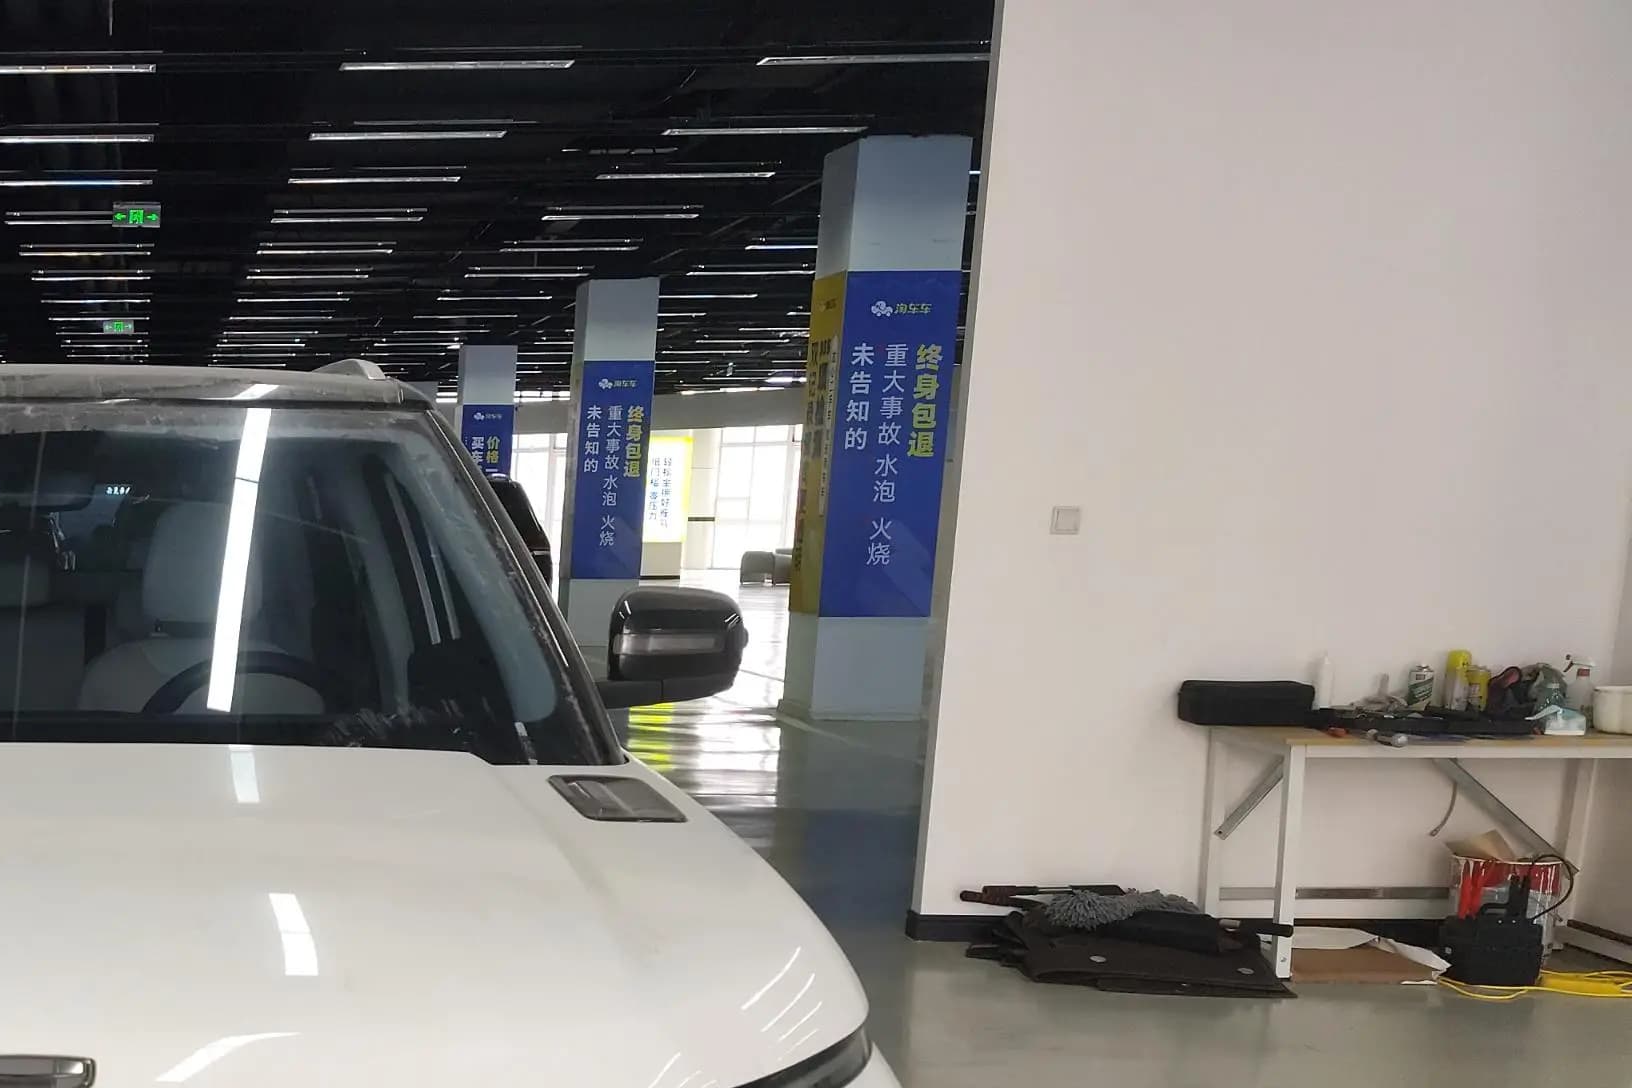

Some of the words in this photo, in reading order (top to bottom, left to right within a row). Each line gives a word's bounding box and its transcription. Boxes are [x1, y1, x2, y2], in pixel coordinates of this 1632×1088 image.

[894, 303, 932, 314] 淘车车
[844, 342, 875, 450] 未告知的
[877, 343, 909, 445] 重大事故
[907, 344, 943, 457] 终身包退
[583, 405, 603, 473] 未告知的
[604, 405, 623, 470] 重大事故
[623, 405, 645, 478] 终身包退
[602, 475, 618, 507] 水泡
[873, 453, 898, 503] 水泡
[599, 514, 615, 547] 火烧
[866, 517, 893, 566] 火烧
